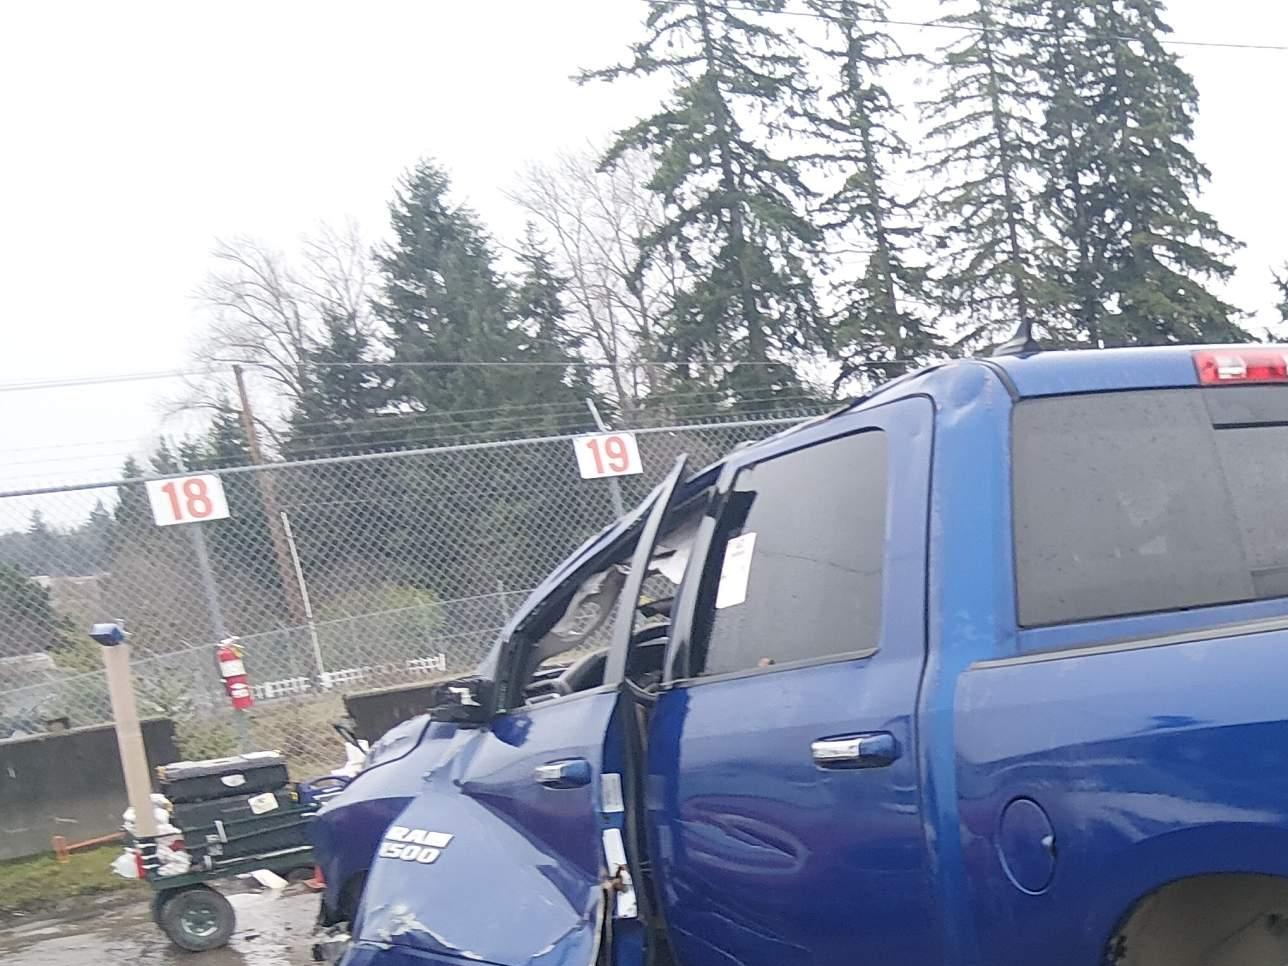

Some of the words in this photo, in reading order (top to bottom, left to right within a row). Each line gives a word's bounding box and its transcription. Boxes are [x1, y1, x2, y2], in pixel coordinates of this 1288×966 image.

[586, 436, 629, 474] 19
[162, 478, 213, 520] 18
[384, 825, 456, 850] RAM
